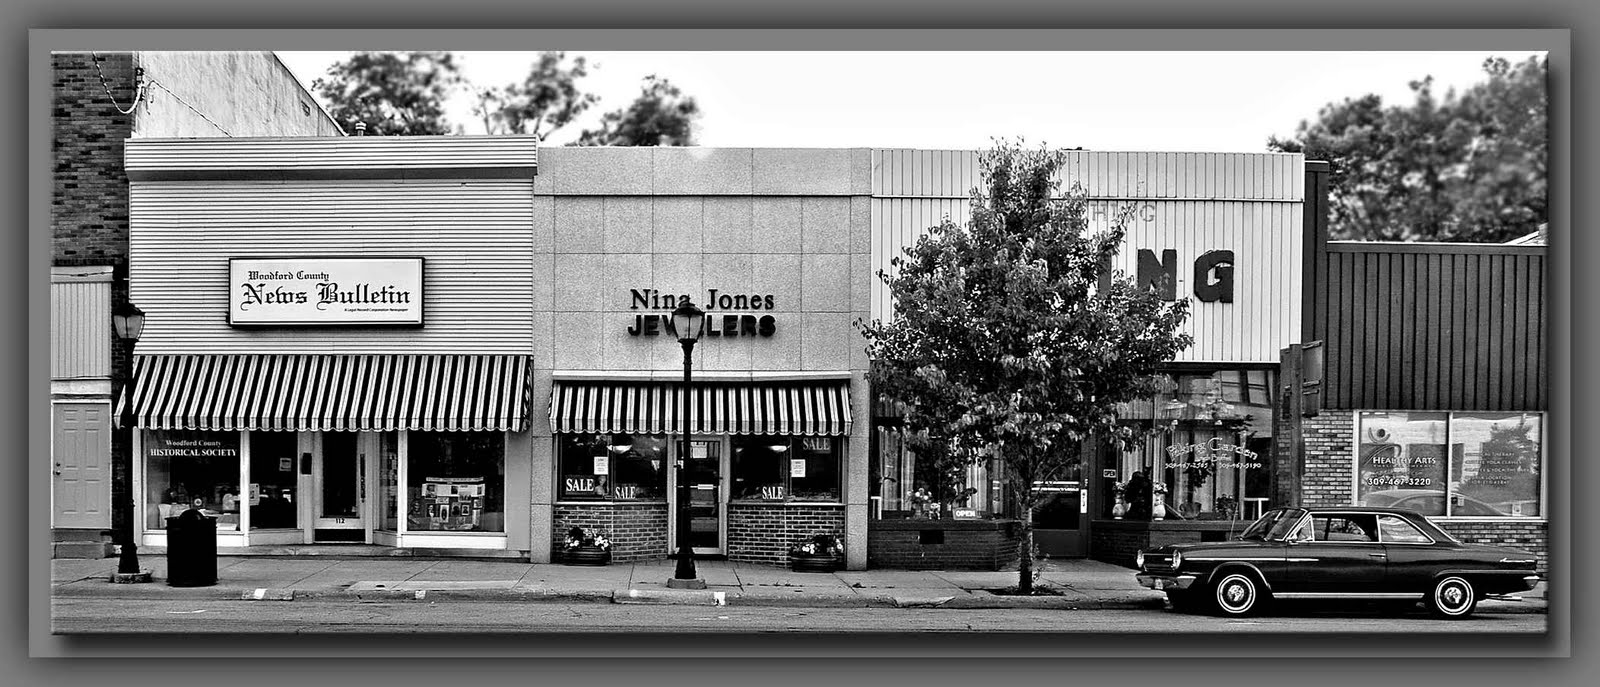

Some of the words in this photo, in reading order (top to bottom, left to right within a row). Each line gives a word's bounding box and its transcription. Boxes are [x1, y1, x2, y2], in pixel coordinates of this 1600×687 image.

[248, 270, 294, 281] Woodford
[296, 270, 330, 281] County
[240, 283, 308, 311] News
[315, 282, 411, 311] Bulletin
[706, 288, 775, 309] Jones
[627, 314, 777, 338] JEWLERS
[802, 437, 832, 451] SALE
[150, 448, 200, 456] HISTORICAL
[201, 448, 236, 456] SOCIETY
[566, 478, 594, 492] SALE
[1367, 477, 1431, 486] 309-467-3220
[615, 486, 636, 499] SALE
[762, 486, 784, 500] SALE
